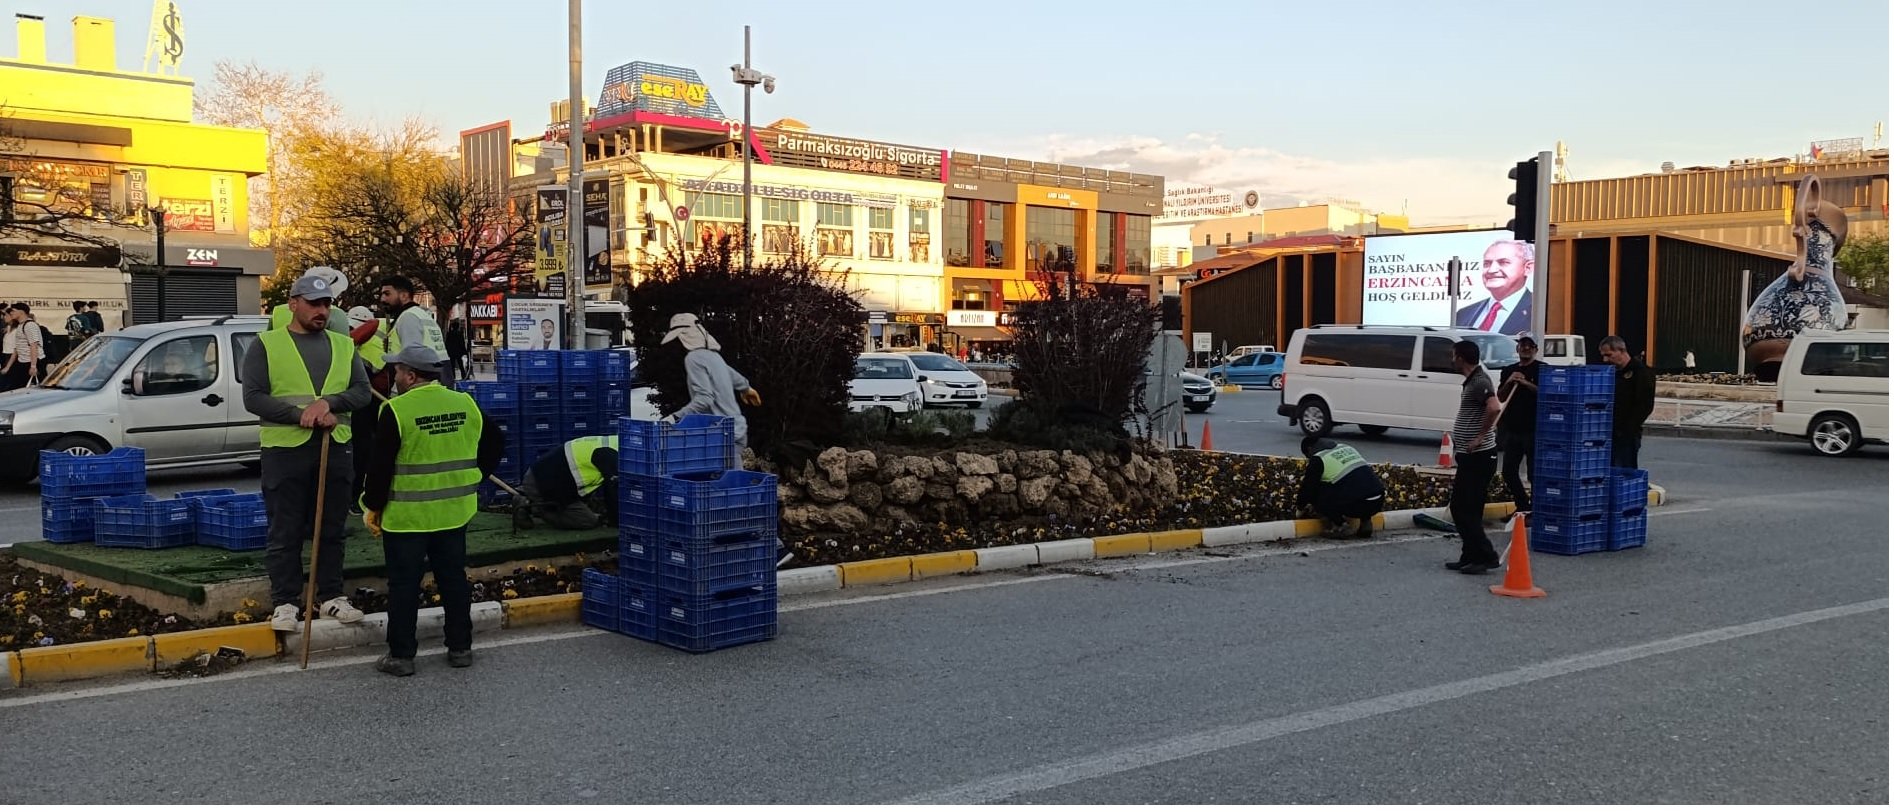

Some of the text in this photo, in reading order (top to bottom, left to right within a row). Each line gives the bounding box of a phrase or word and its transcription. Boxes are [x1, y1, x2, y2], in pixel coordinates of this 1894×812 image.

[778, 134, 935, 166] Parmaksızoğlu Sigorta
[187, 248, 218, 260] ZEN
[1368, 254, 1405, 264] SAYIN
[1369, 261, 1480, 275] BAŞBAKANIZ
[1368, 290, 1472, 303] HOŞ GELDİİZ
